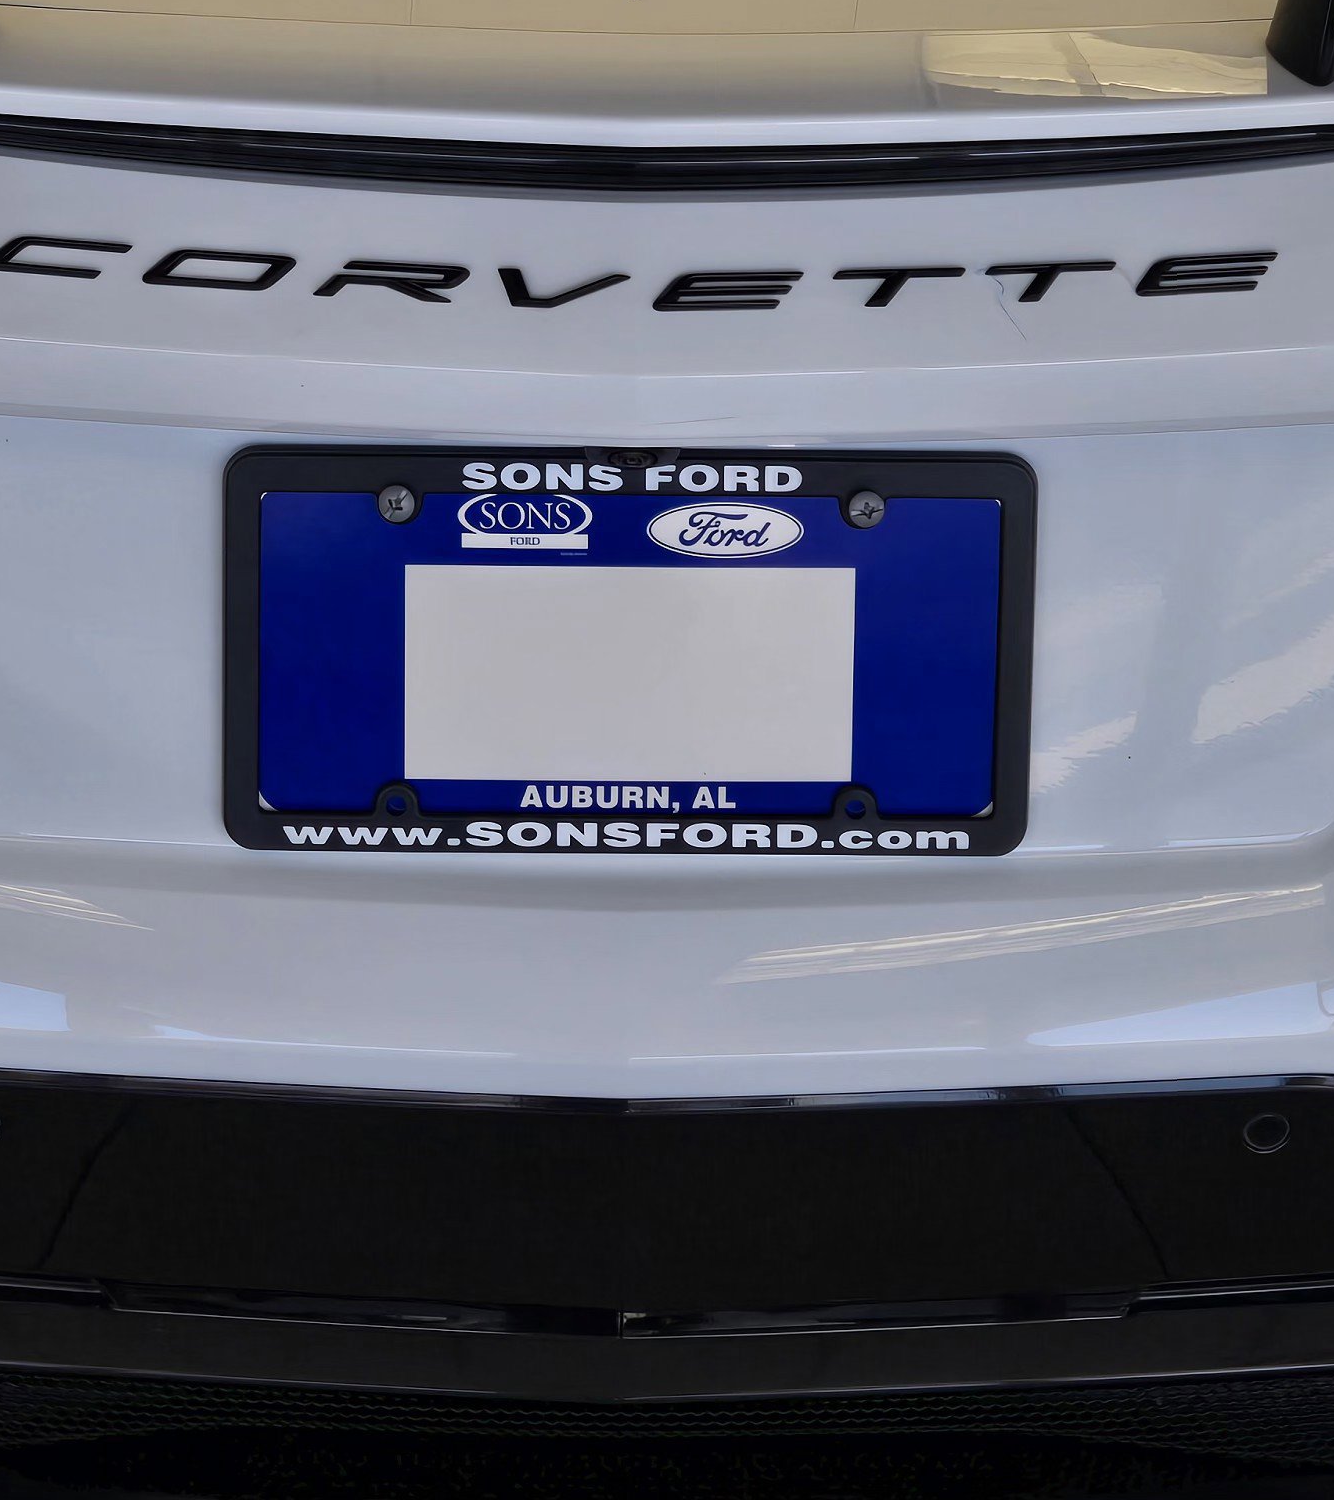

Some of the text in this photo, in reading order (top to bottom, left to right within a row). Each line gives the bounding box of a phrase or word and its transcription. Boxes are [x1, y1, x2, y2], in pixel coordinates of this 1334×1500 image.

[461, 461, 804, 493] SONS FORD
[478, 500, 573, 531] SONS
[678, 510, 772, 548] Ford
[509, 535, 541, 547] FORD
[520, 785, 737, 813] AUBURN, AL
[282, 820, 971, 850] www.SONSFORD.com
